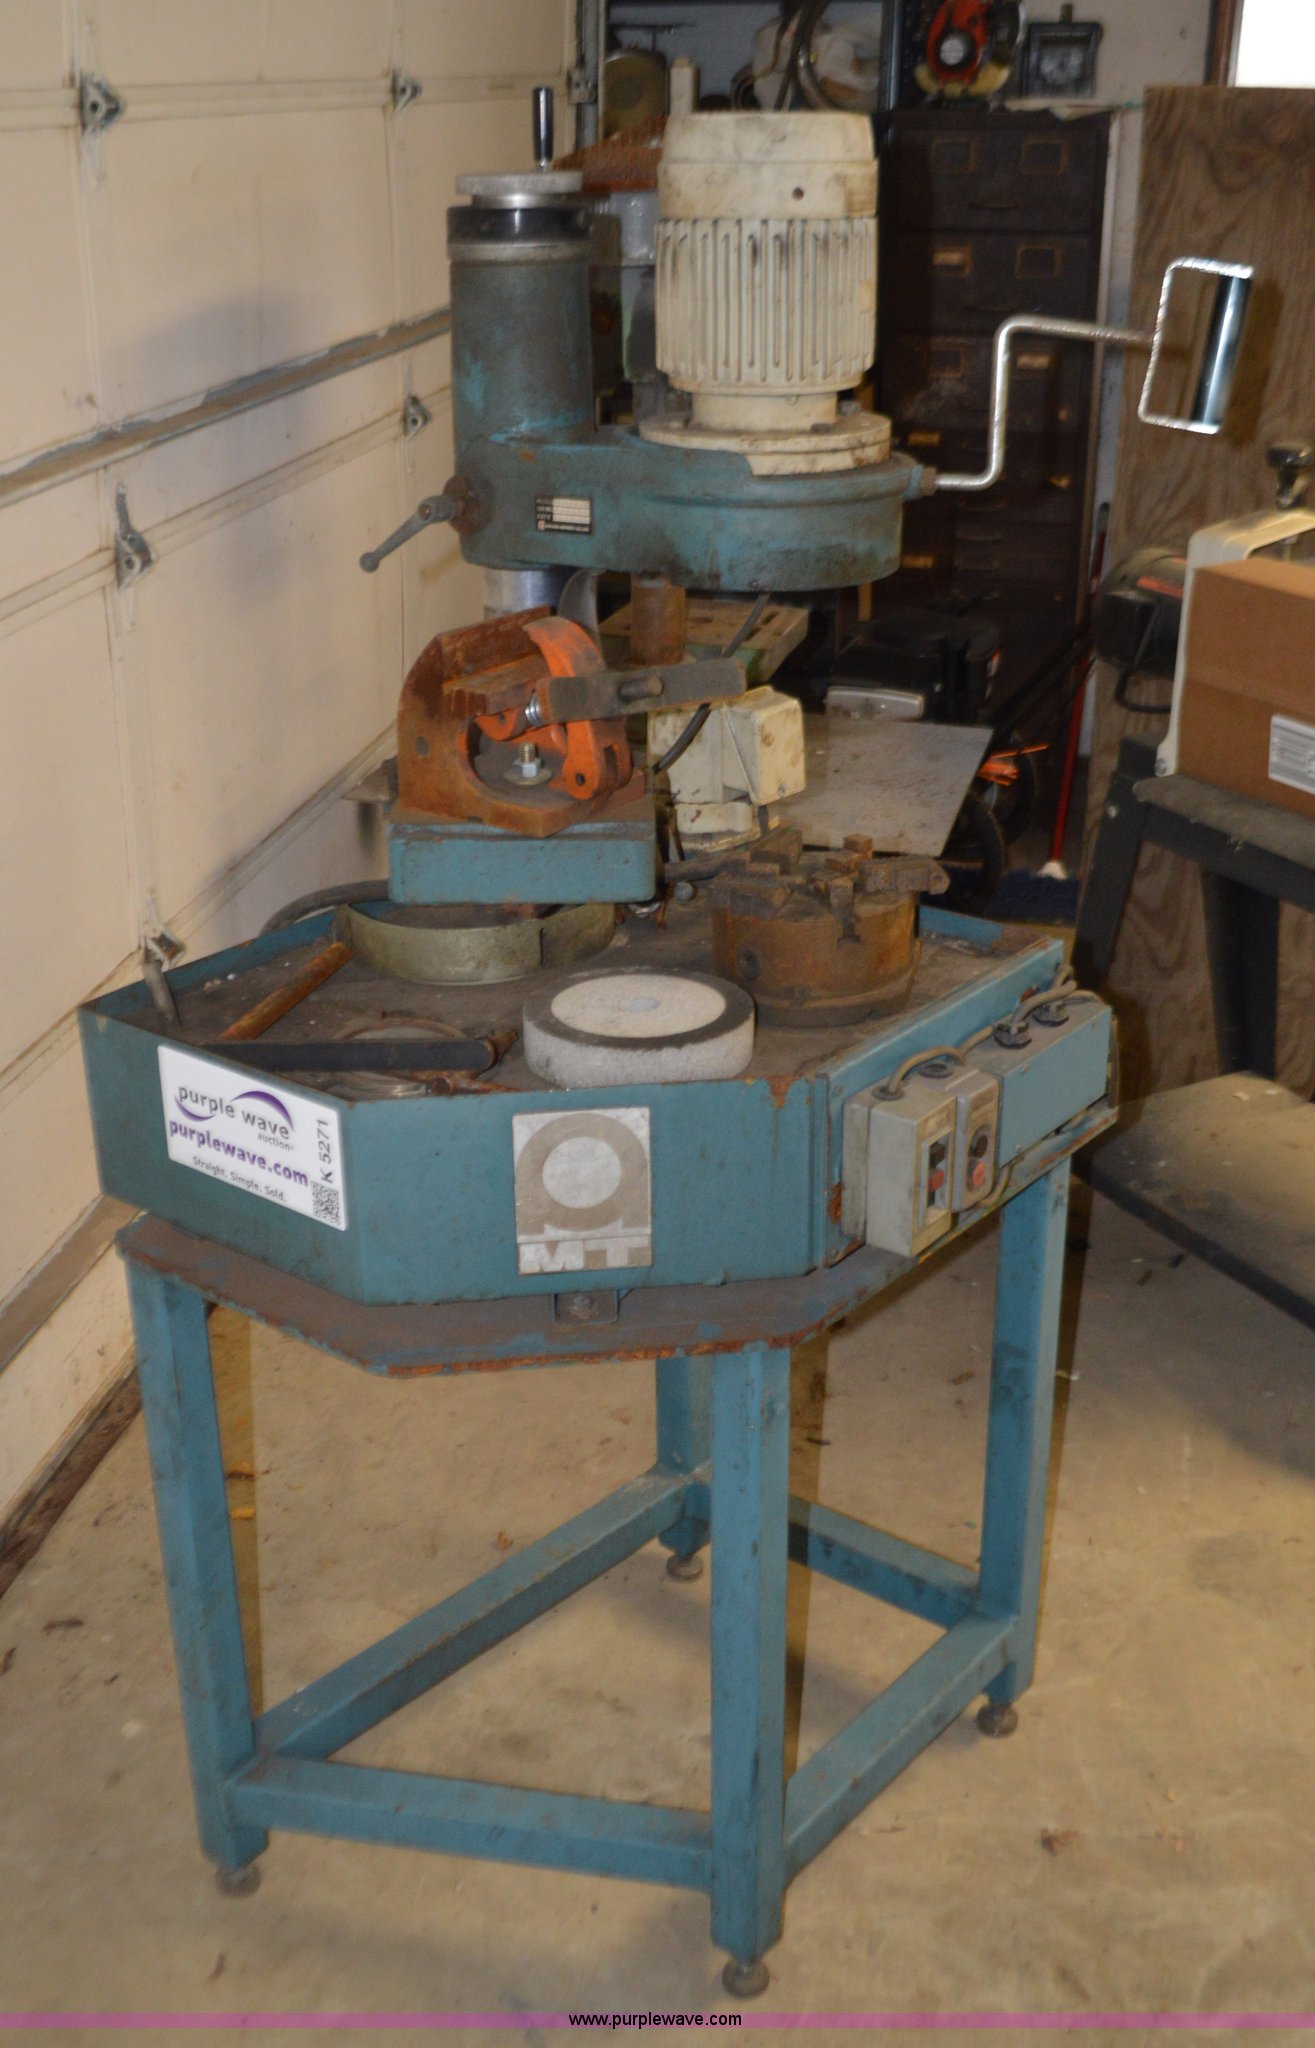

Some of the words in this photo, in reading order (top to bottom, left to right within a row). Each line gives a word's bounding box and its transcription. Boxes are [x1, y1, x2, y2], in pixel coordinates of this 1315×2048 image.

[178, 1085, 235, 1119] purple
[241, 1111, 290, 1139] wave
[169, 1120, 309, 1187] purplewave.com
[257, 1132, 291, 1151] auction
[316, 1119, 332, 1164] 5271
[192, 1156, 228, 1179] Straight.
[230, 1172, 262, 1192] Simple.
[265, 1186, 287, 1202] Sold.
[321, 1170, 334, 1183] K
